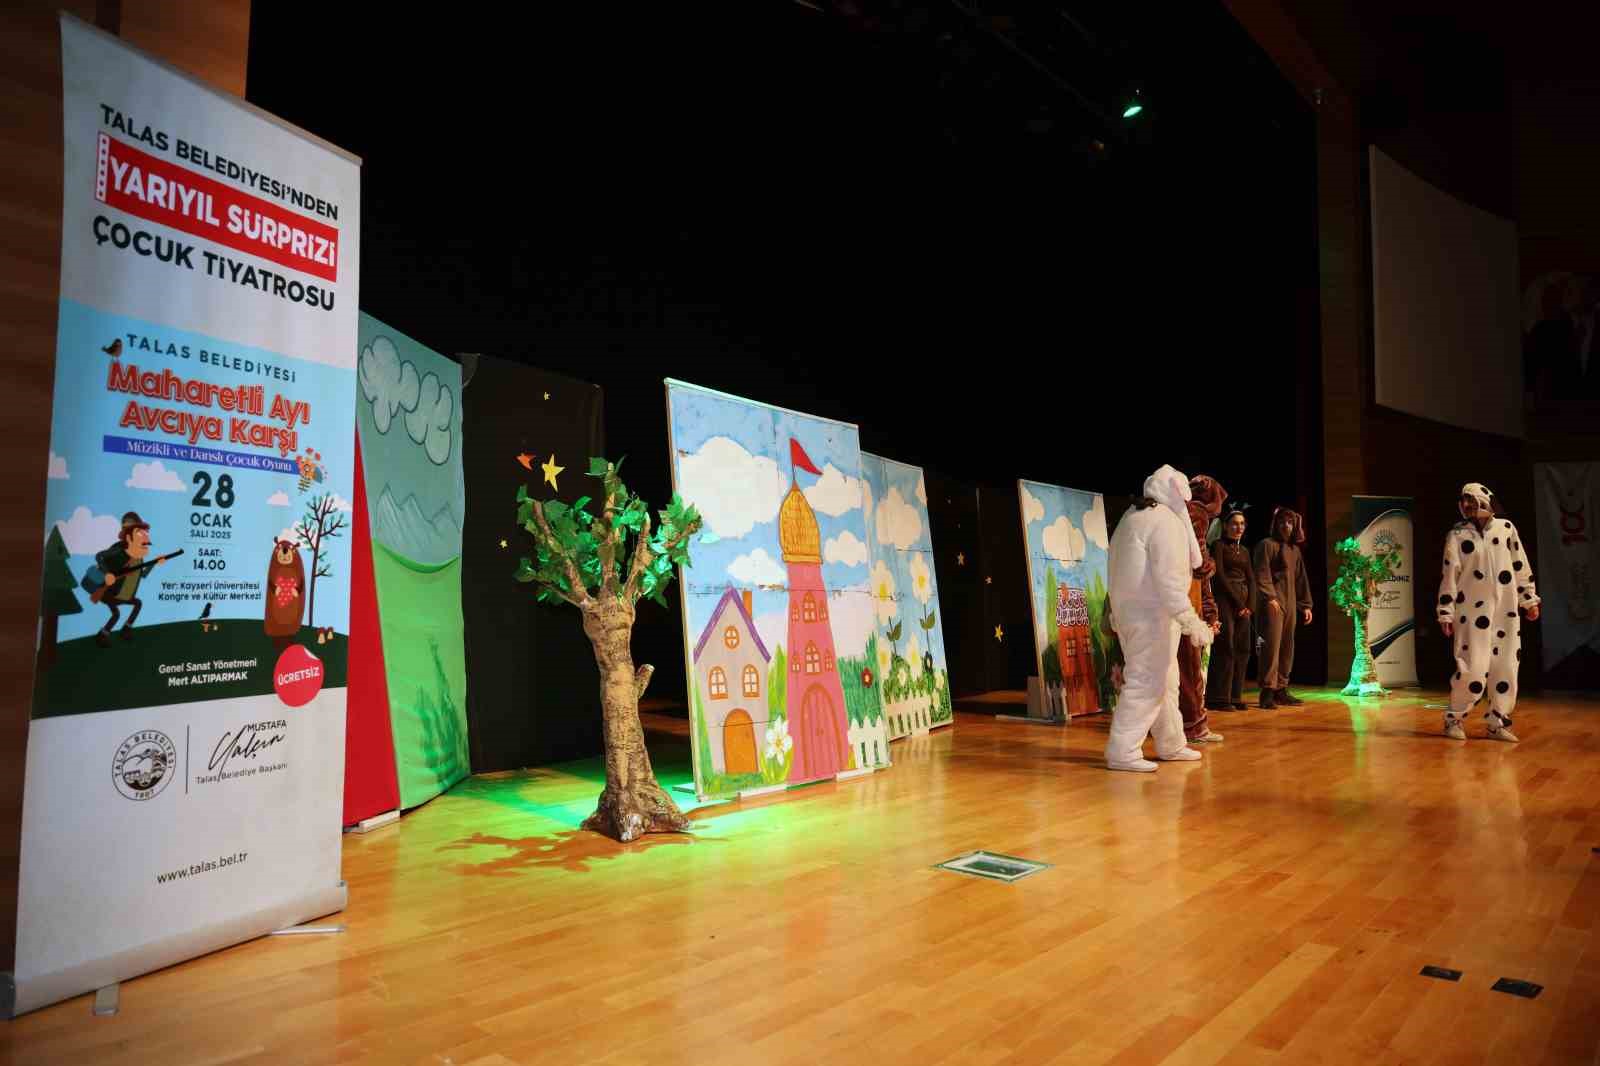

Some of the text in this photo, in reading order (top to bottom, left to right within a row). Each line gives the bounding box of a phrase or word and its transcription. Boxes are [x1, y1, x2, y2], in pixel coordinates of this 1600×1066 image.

[101, 104, 168, 151] TALAS
[110, 156, 335, 266] YARIYIL SÜRPRİZİ
[93, 215, 334, 310] ÇOCUK TİYATROSU
[127, 333, 296, 382] TALAS BELEDİYESİ
[107, 361, 264, 416] Maharetli
[120, 401, 298, 457] Avcıya Karşı
[127, 440, 292, 472] Müzikli ve Danslı Çocuk Oyunu
[192, 470, 235, 509] 28
[190, 512, 232, 528] OCAK
[190, 529, 231, 539] SALI 2025
[198, 548, 222, 557] SAAT:
[193, 559, 226, 571] 14.00
[161, 580, 260, 592] Yer: Kayseri Üniversitesi
[158, 592, 189, 602] Kongre
[203, 592, 228, 601] Kültür
[229, 592, 261, 601] Merkezi
[159, 658, 257, 674] Genel Sanat Yönetmeni
[168, 671, 248, 687] Mert ALTIPARMAK
[278, 667, 320, 686] ÜCRETSİZ
[247, 719, 287, 732] MUSTAFA
[195, 774, 217, 784] Talas
[221, 767, 257, 780] Belediye
[156, 852, 248, 884] www.talas.bel.tr
